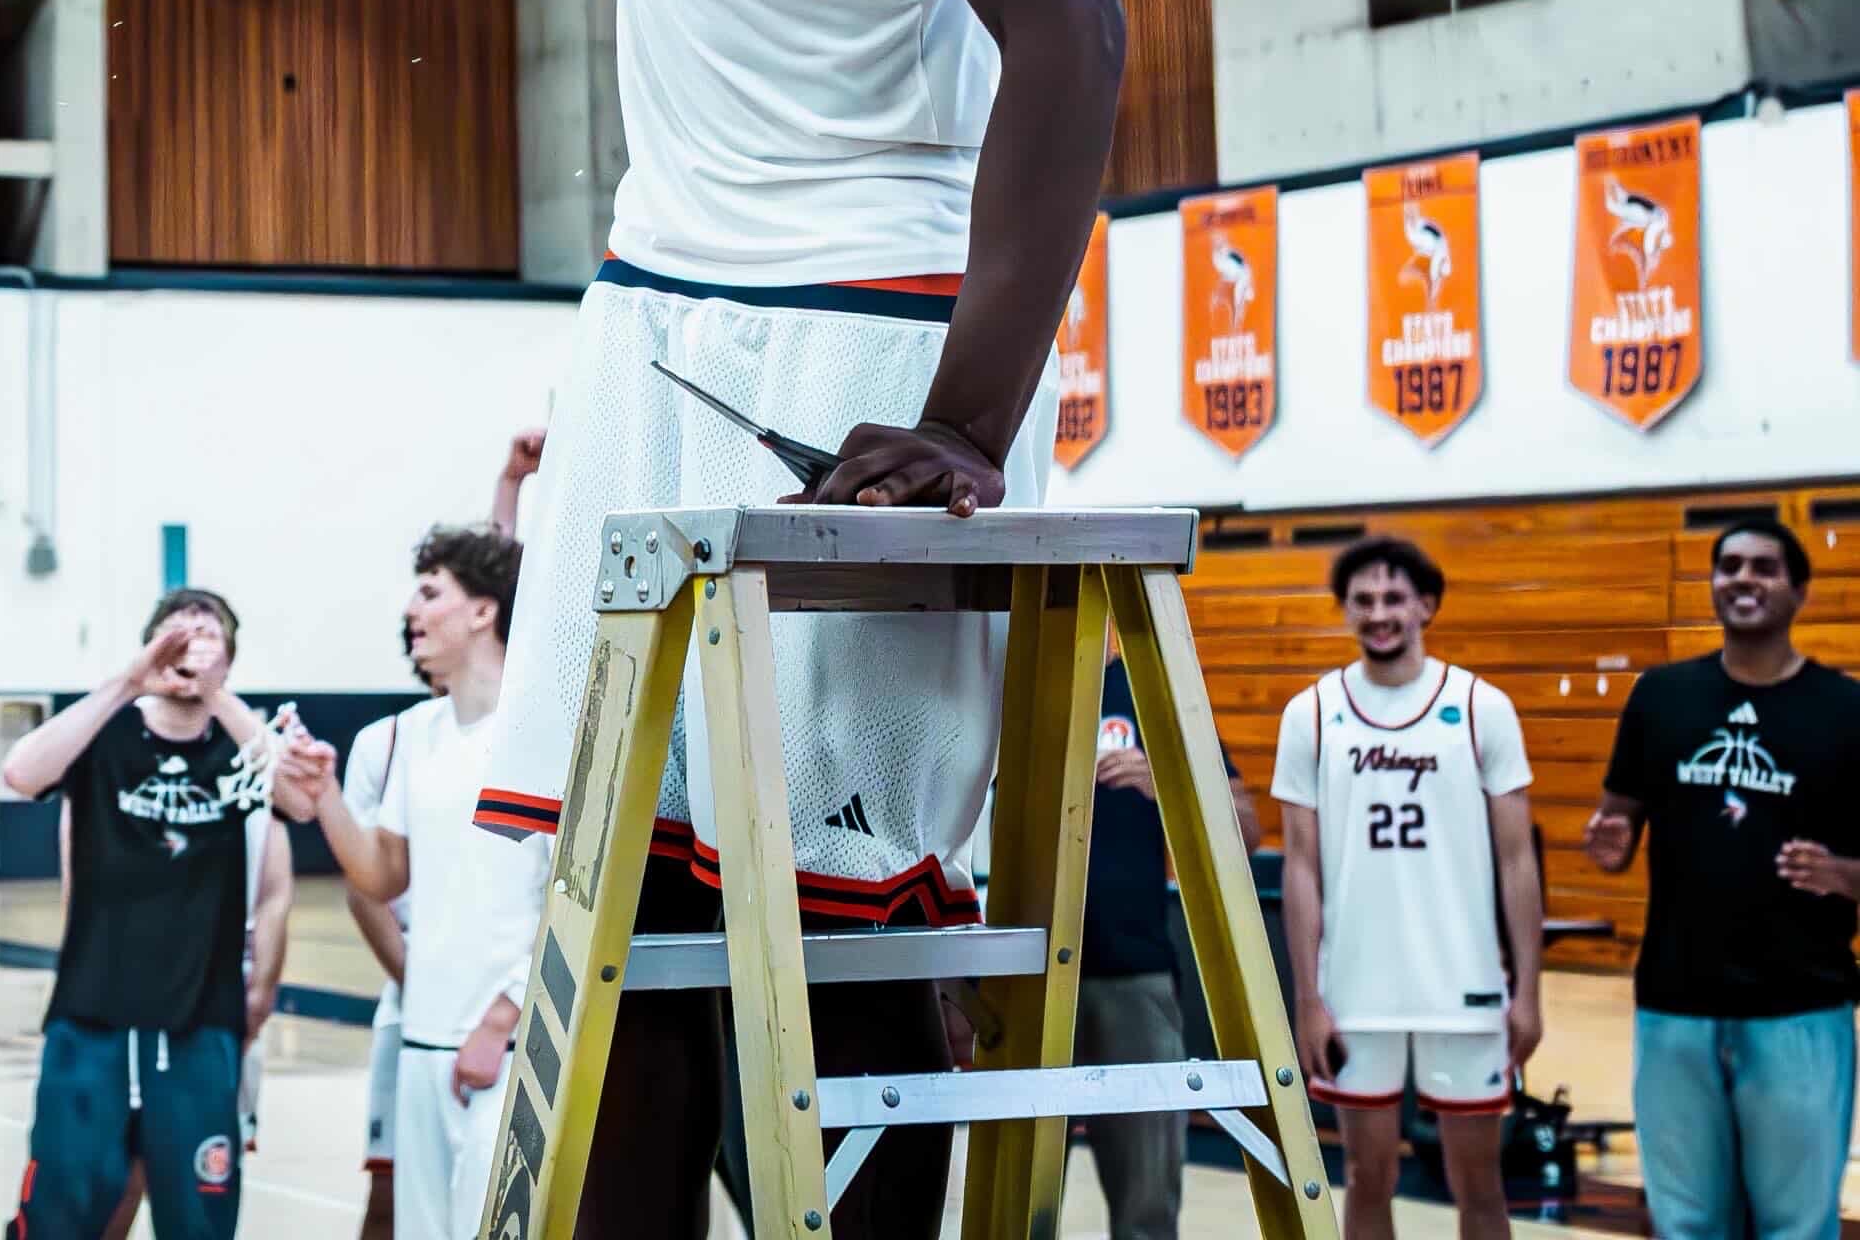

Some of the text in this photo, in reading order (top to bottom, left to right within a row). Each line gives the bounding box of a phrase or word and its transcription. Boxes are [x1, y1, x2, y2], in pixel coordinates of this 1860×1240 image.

[1394, 363, 1463, 416] 1987
[1602, 340, 1682, 396] 1987
[1205, 382, 1264, 430] 1983
[1348, 744, 1438, 792] Vikings
[1677, 760, 1796, 796] WEST VALLEY
[1367, 803, 1427, 849] 22
